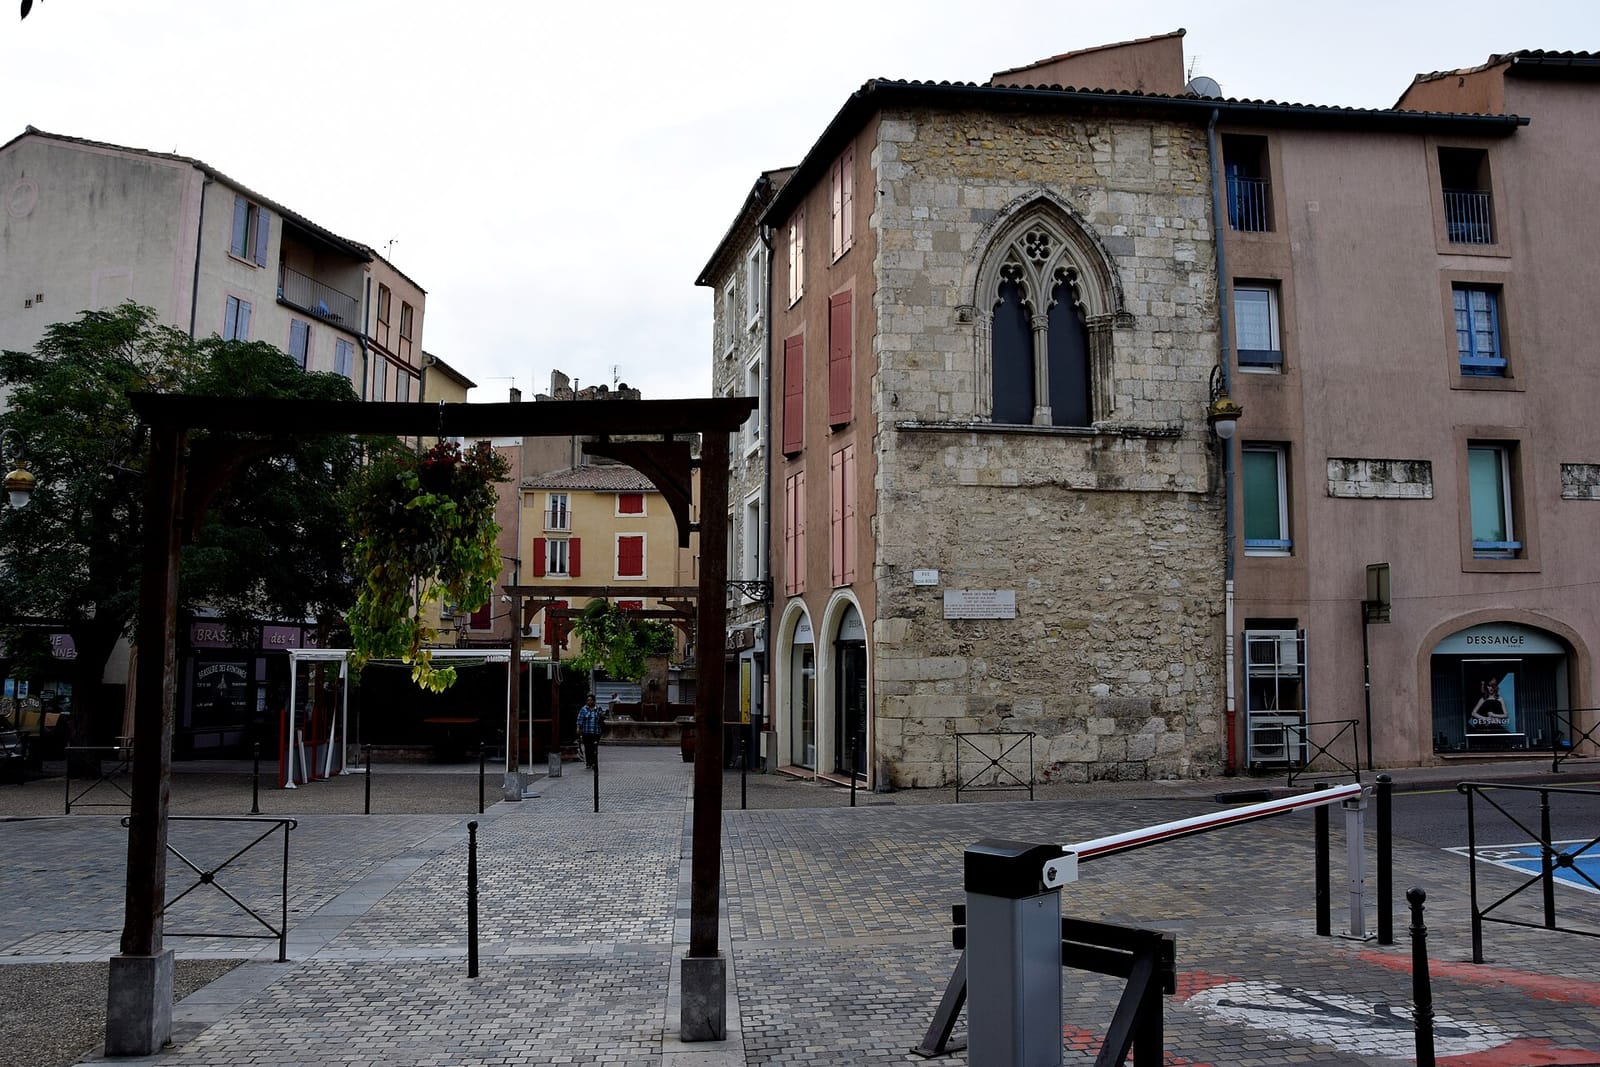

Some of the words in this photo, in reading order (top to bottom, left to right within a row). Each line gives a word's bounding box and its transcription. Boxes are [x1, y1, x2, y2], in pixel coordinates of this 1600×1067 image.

[271, 633, 286, 643] des
[289, 633, 296, 643] 4
[1467, 635, 1525, 645] DESSANGE
